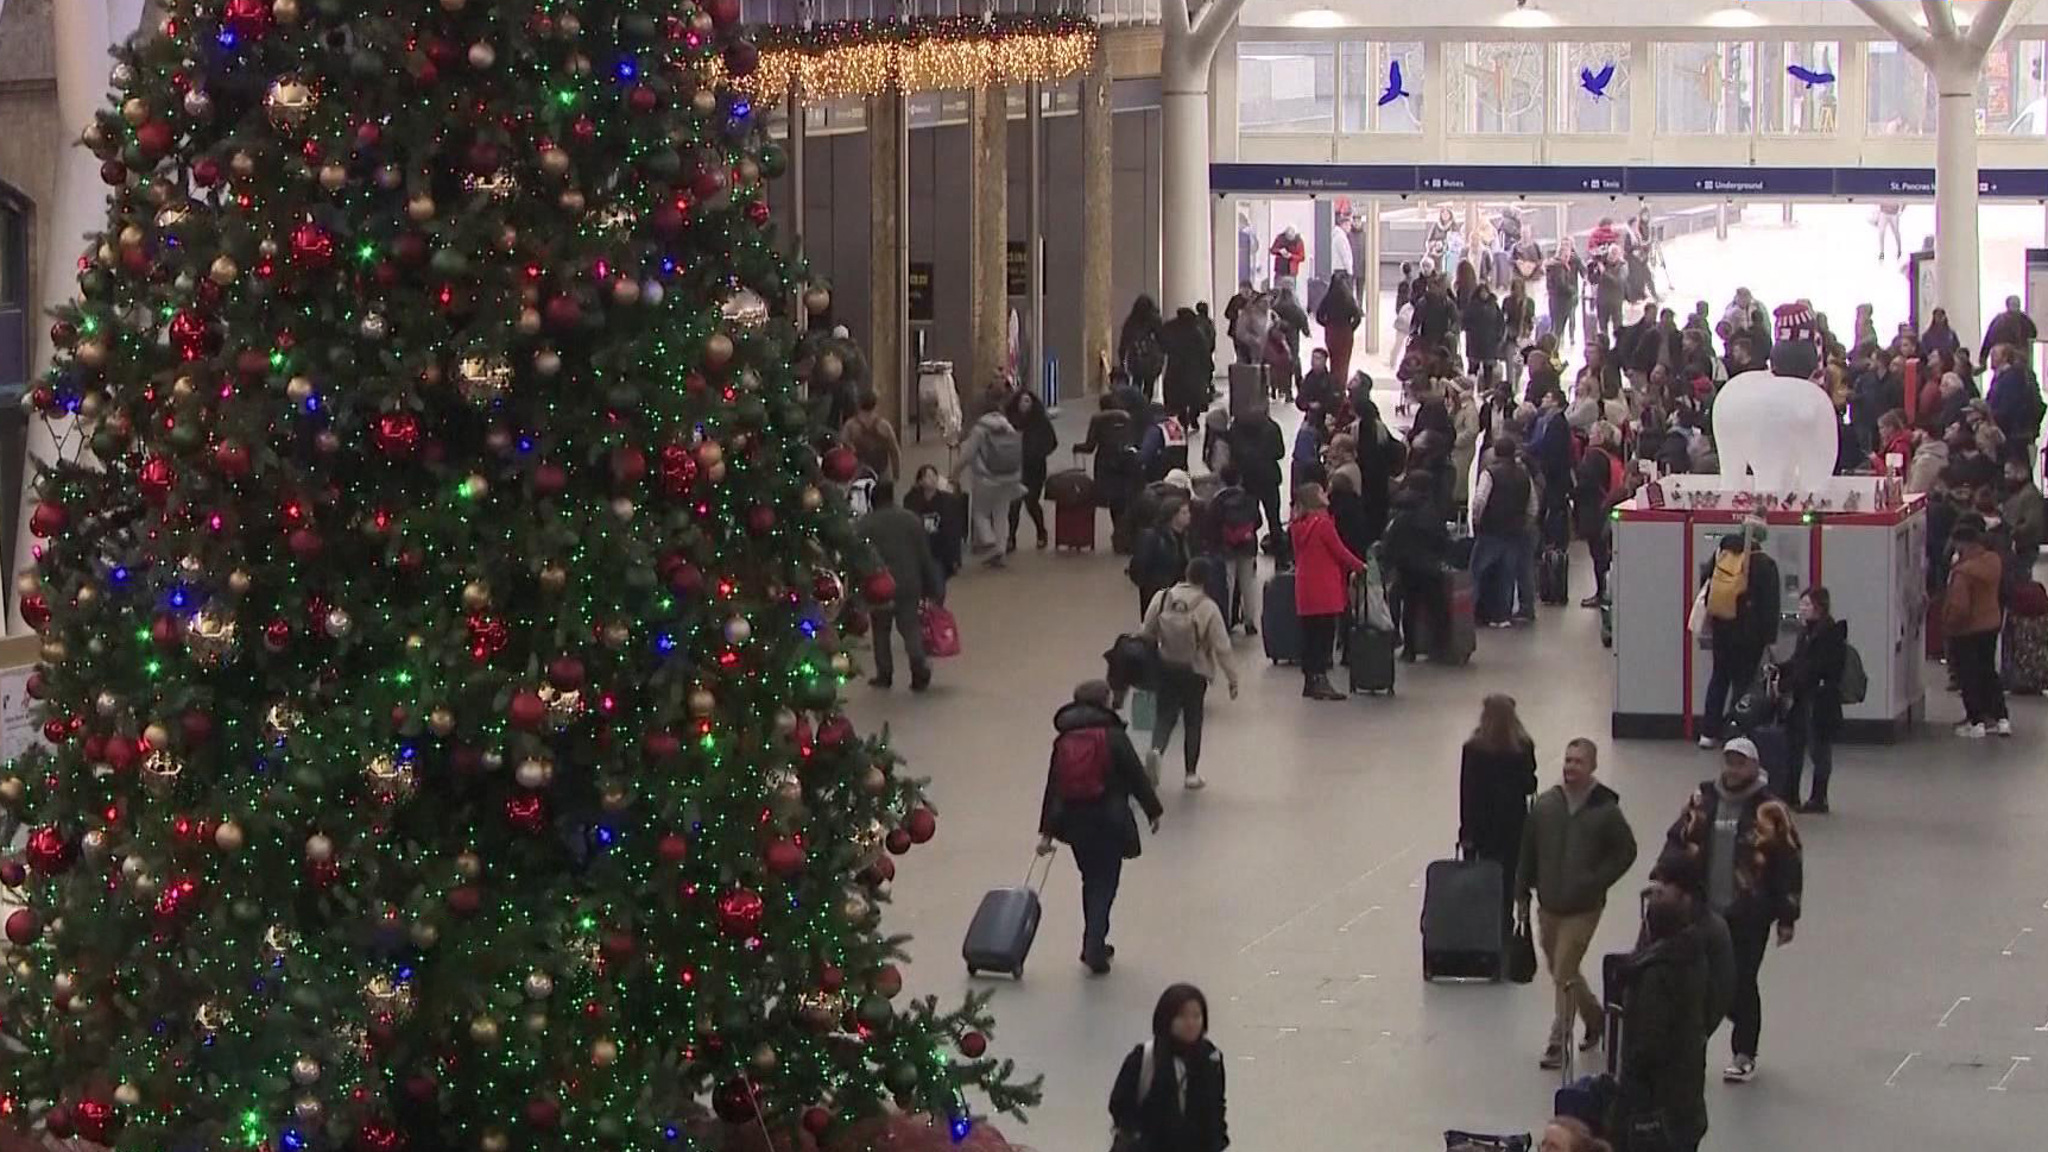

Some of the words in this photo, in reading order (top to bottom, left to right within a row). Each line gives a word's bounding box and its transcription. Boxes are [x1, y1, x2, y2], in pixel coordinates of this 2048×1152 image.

[1293, 178, 1310, 187] Way
[1311, 178, 1324, 186] out
[1442, 179, 1464, 188] Buses
[1602, 180, 1620, 189] Taxis
[1714, 180, 1764, 190] Underground
[1890, 182, 1900, 191] St.
[1902, 182, 1930, 191] Pancras
